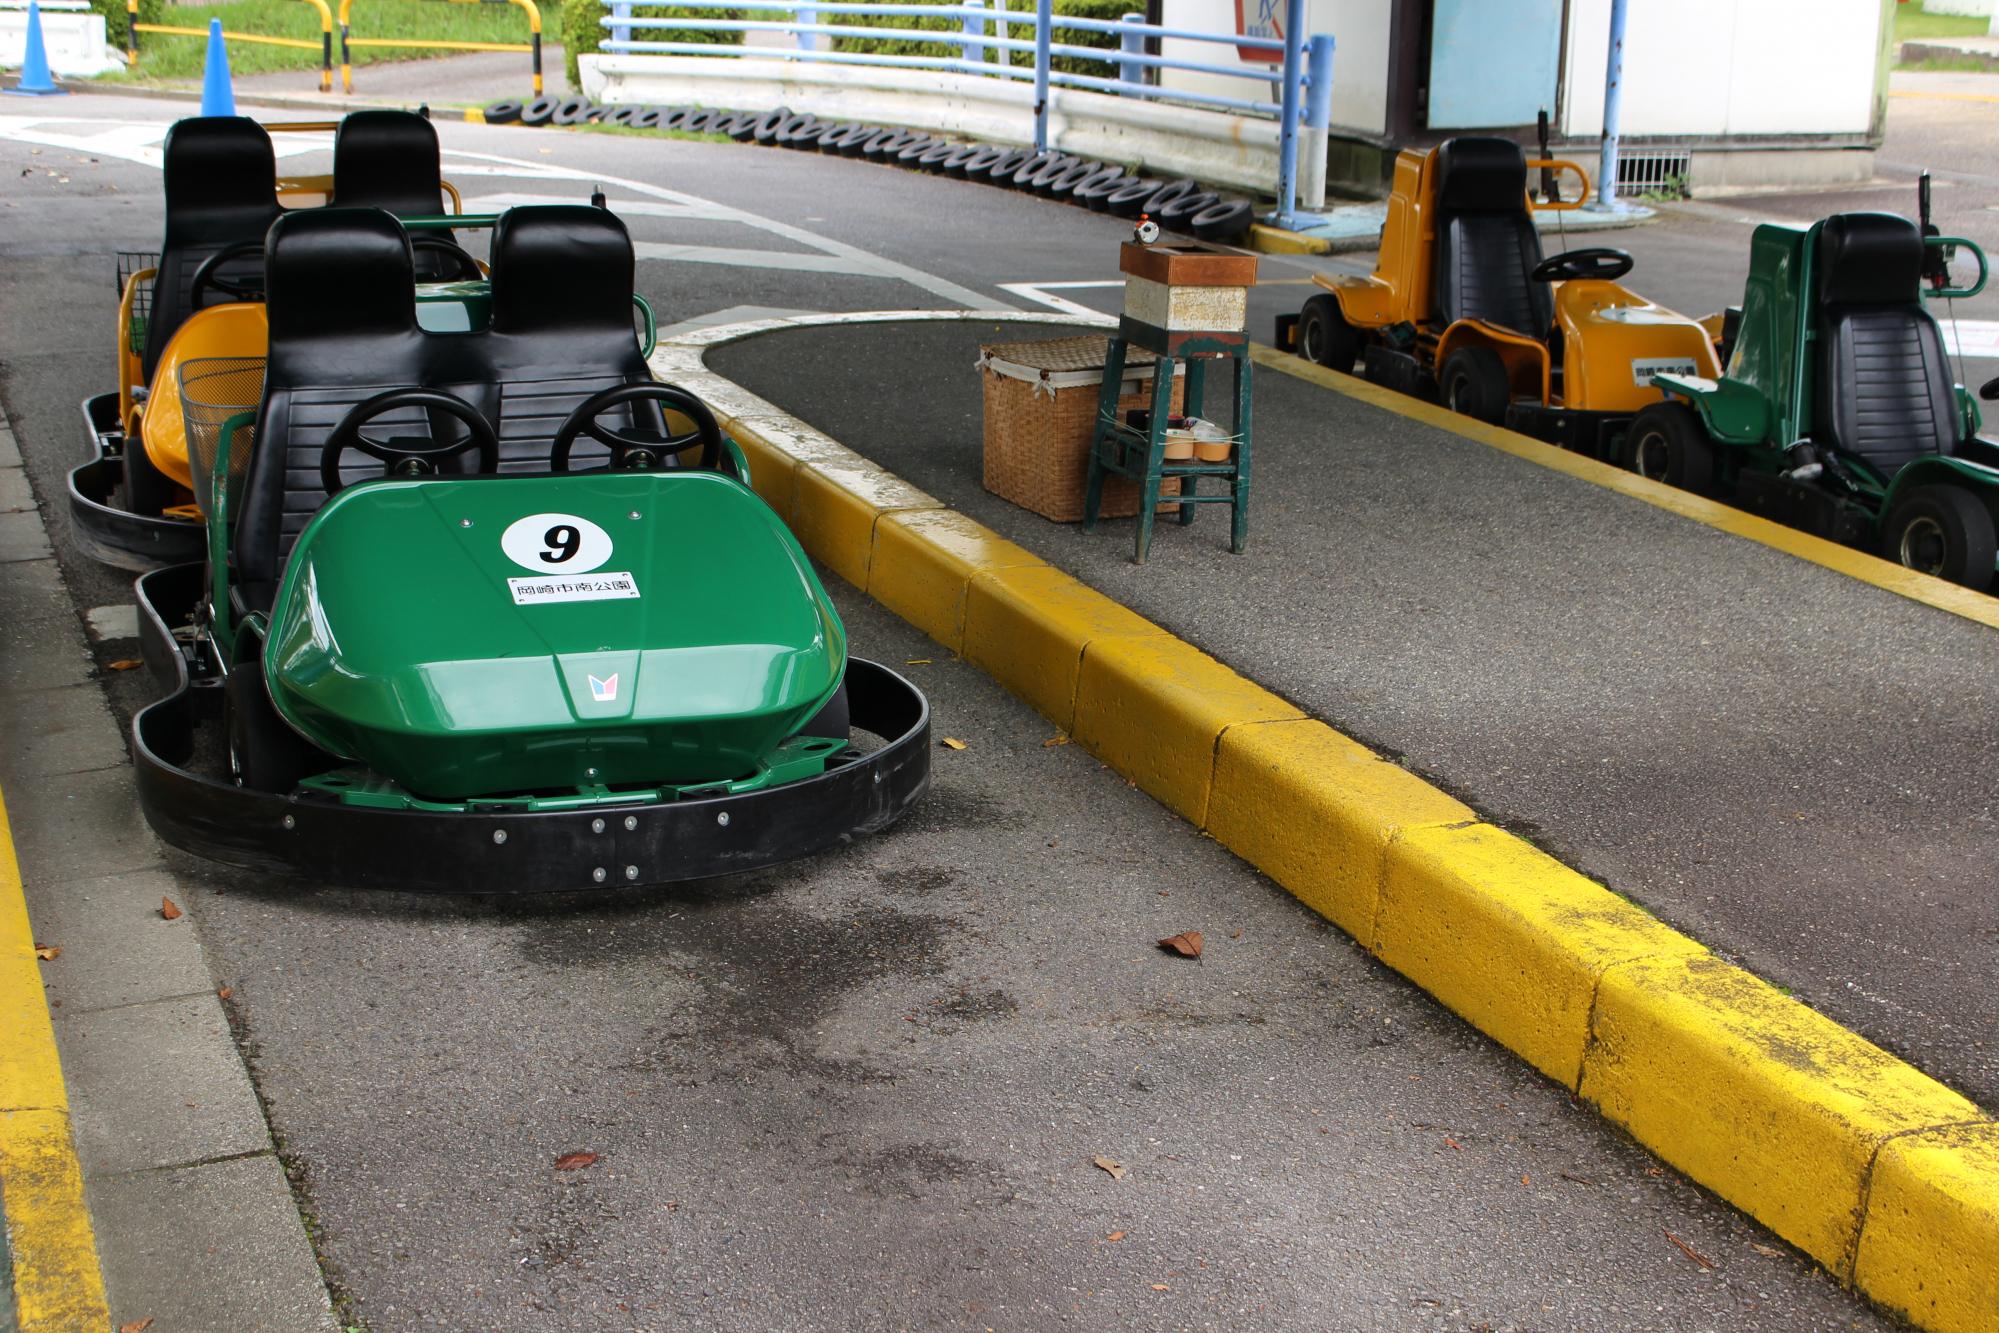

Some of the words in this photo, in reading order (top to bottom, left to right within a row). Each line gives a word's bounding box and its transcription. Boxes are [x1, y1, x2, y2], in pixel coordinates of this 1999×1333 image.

[539, 525, 581, 563] 9
[517, 580, 631, 596] 岡崎市南公園
